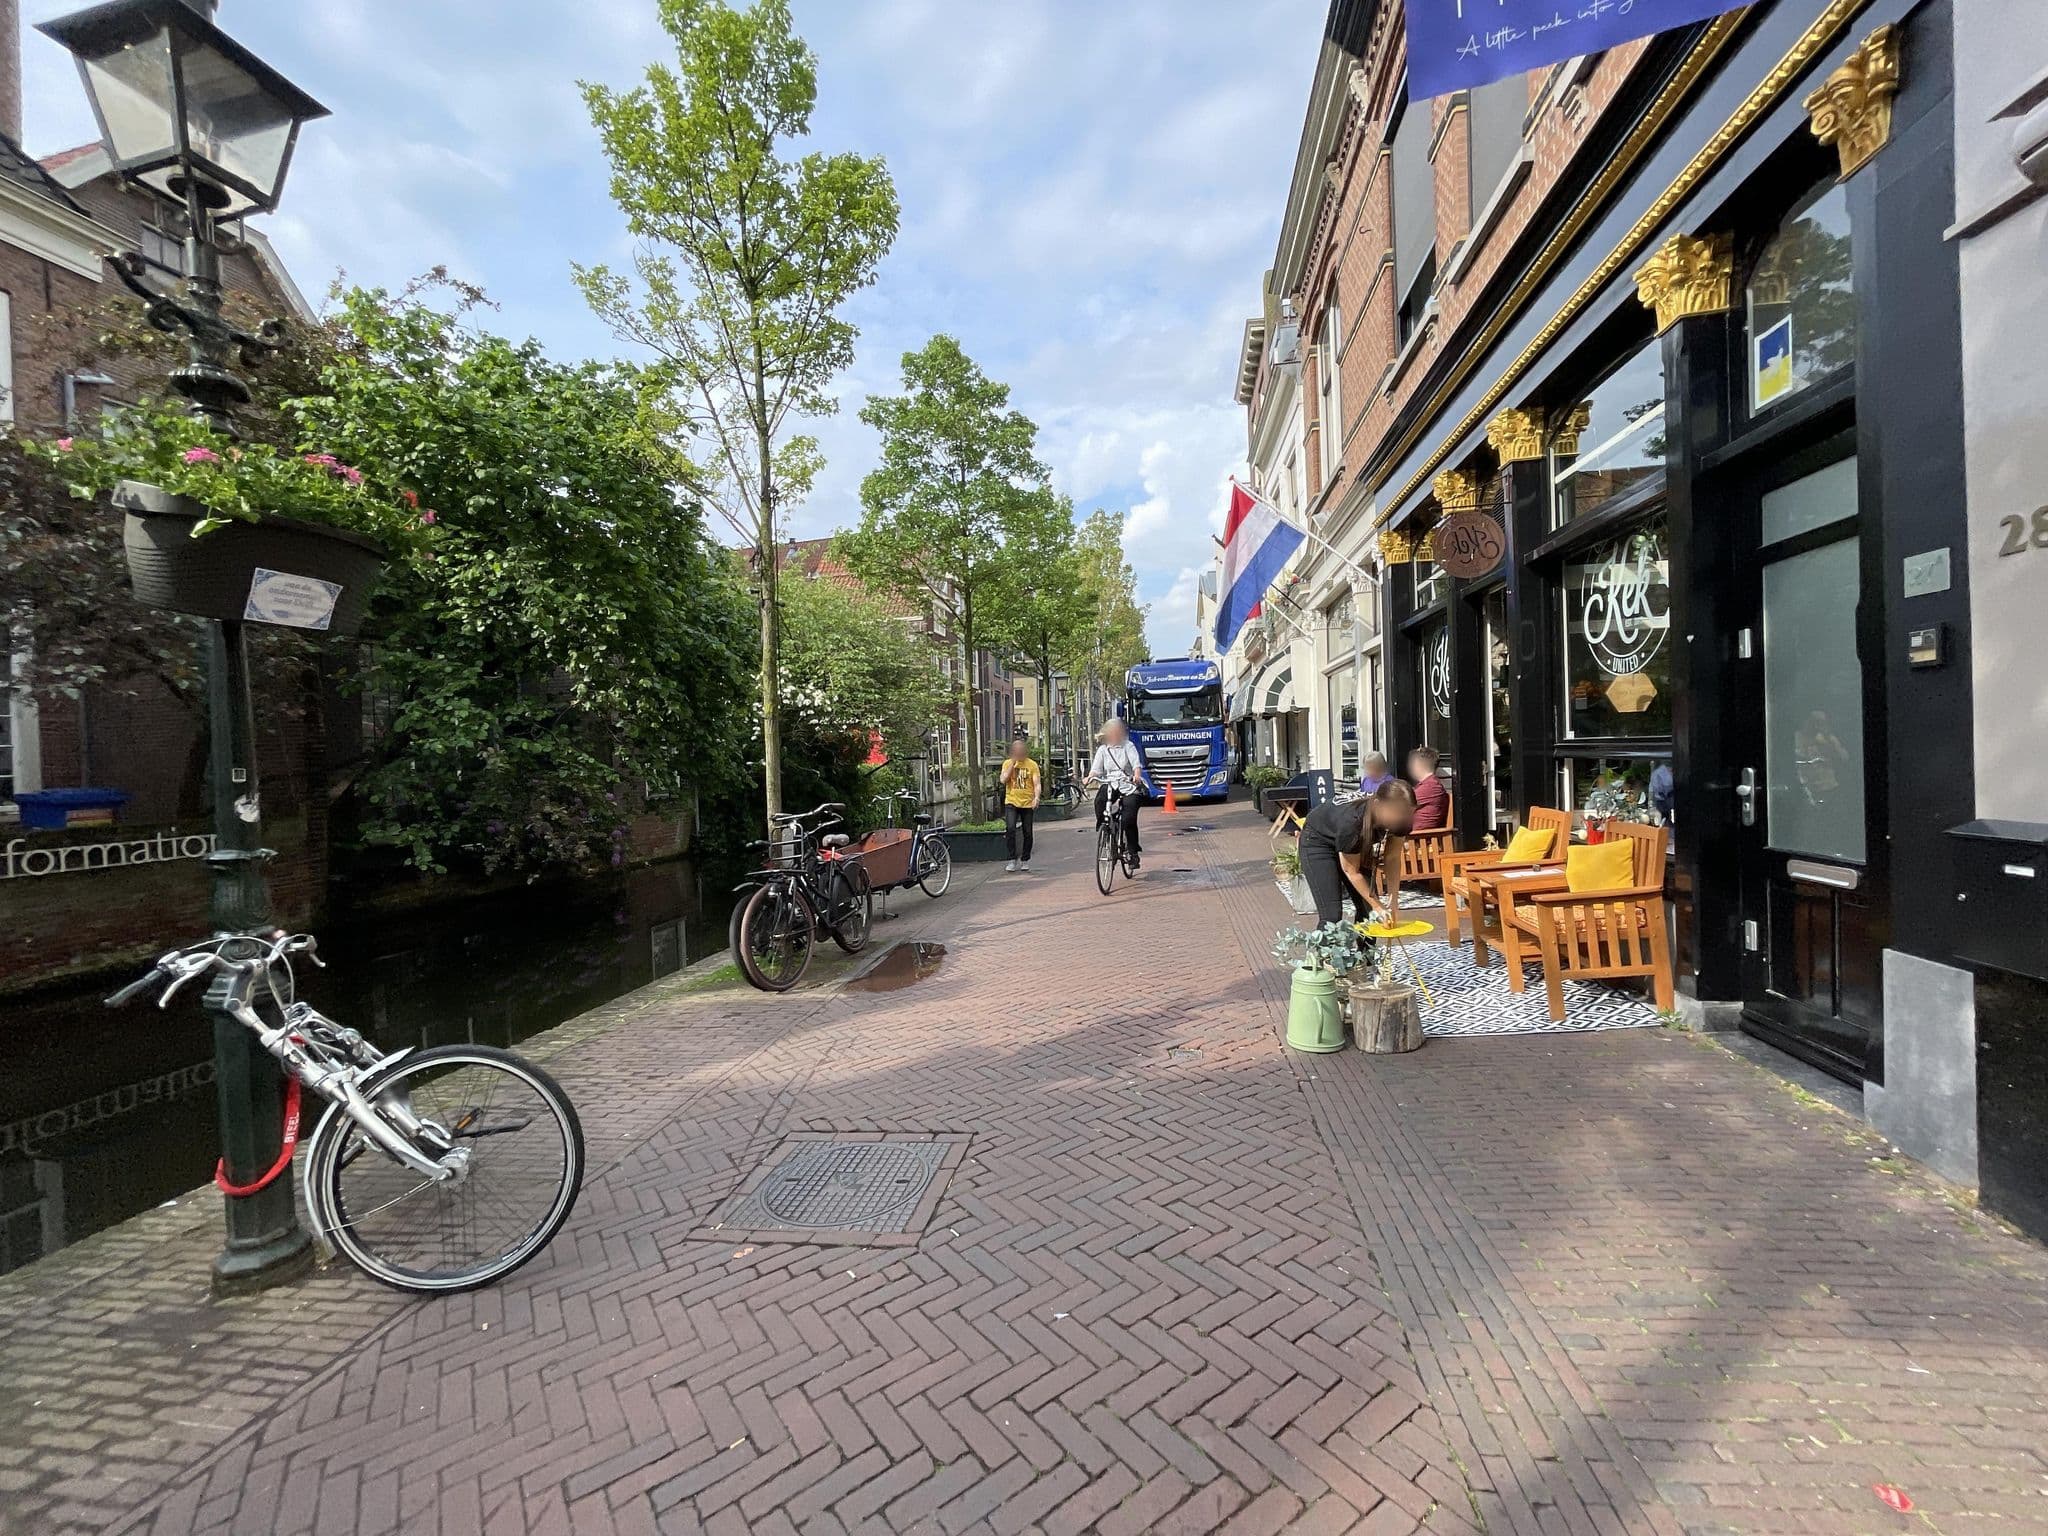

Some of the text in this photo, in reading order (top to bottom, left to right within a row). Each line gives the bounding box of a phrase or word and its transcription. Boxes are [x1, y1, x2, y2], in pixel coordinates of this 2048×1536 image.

[1455, 34, 1481, 63] A
[1485, 26, 1528, 50] little
[1533, 12, 1572, 41] peek
[1612, 654, 1639, 673] UNITED
[1141, 731, 1213, 743] INT. VERHUIZINGEN
